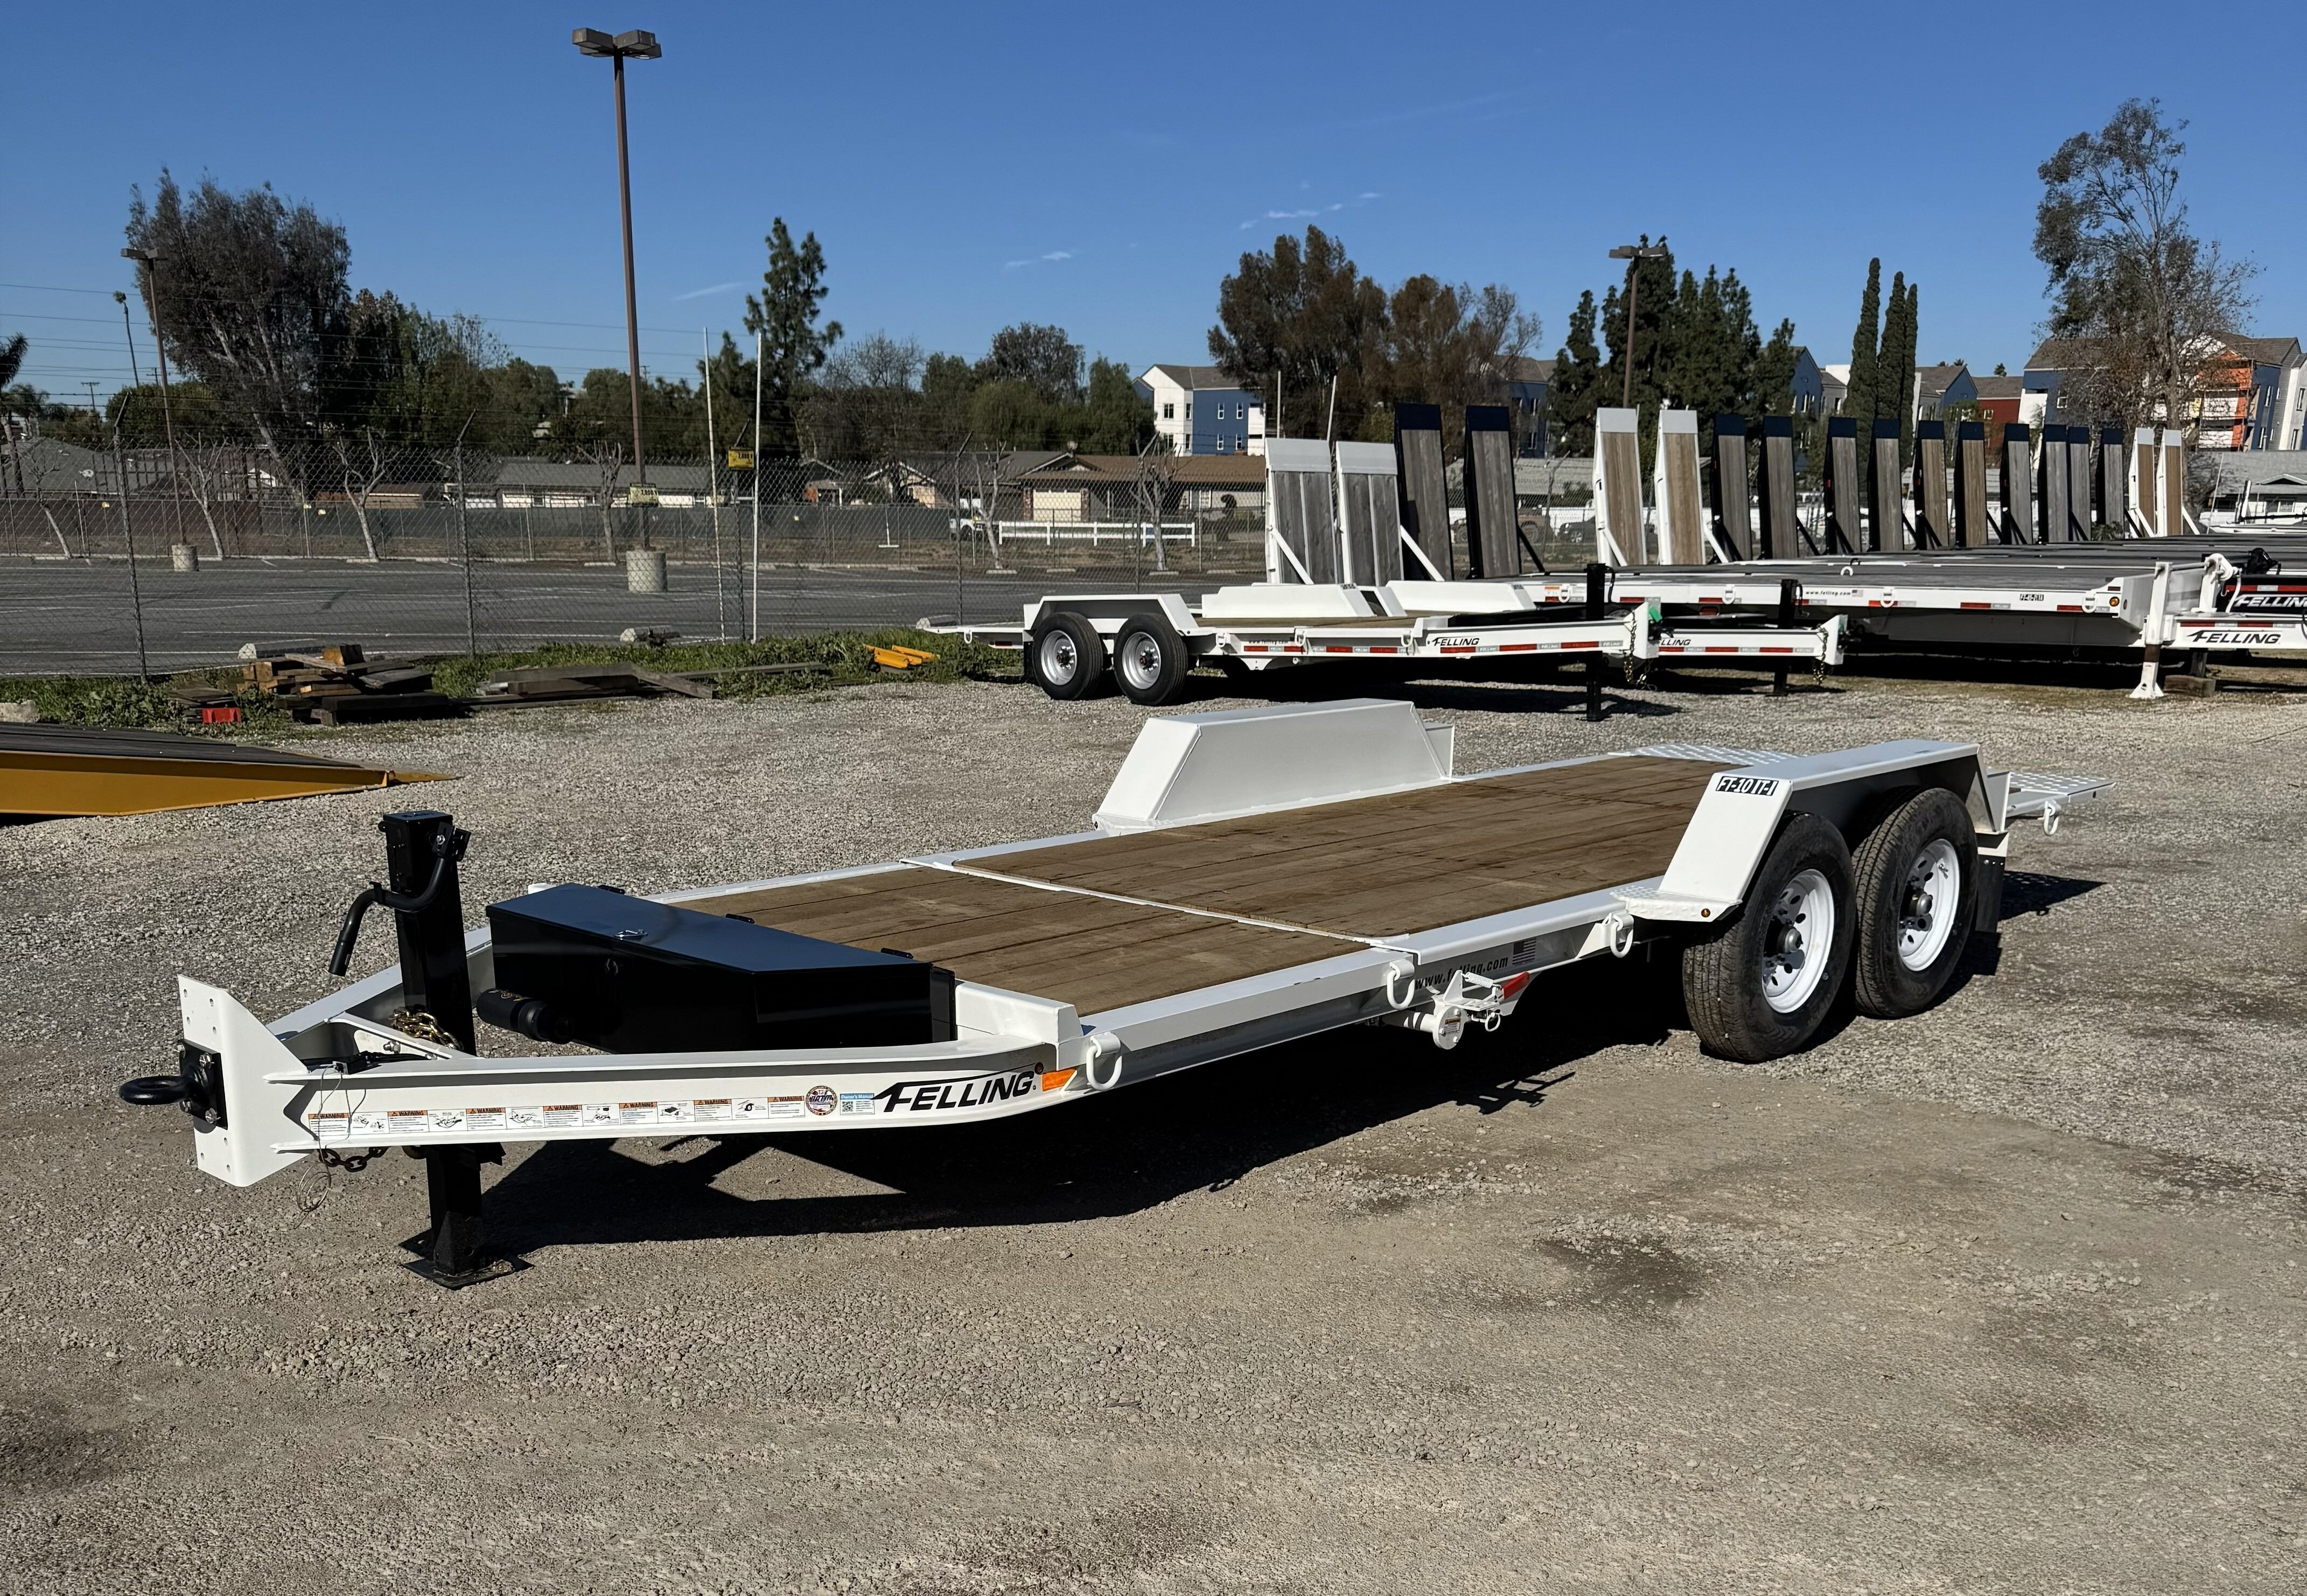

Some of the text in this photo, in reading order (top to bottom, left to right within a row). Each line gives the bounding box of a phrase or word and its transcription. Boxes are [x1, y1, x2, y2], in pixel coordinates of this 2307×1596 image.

[1432, 637, 1480, 646] FELLING
[2187, 629, 2281, 644] FELLING
[1717, 777, 1754, 793] FT-10
[1415, 957, 1508, 990] www.fling.com
[871, 1068, 1035, 1112] FELLING
